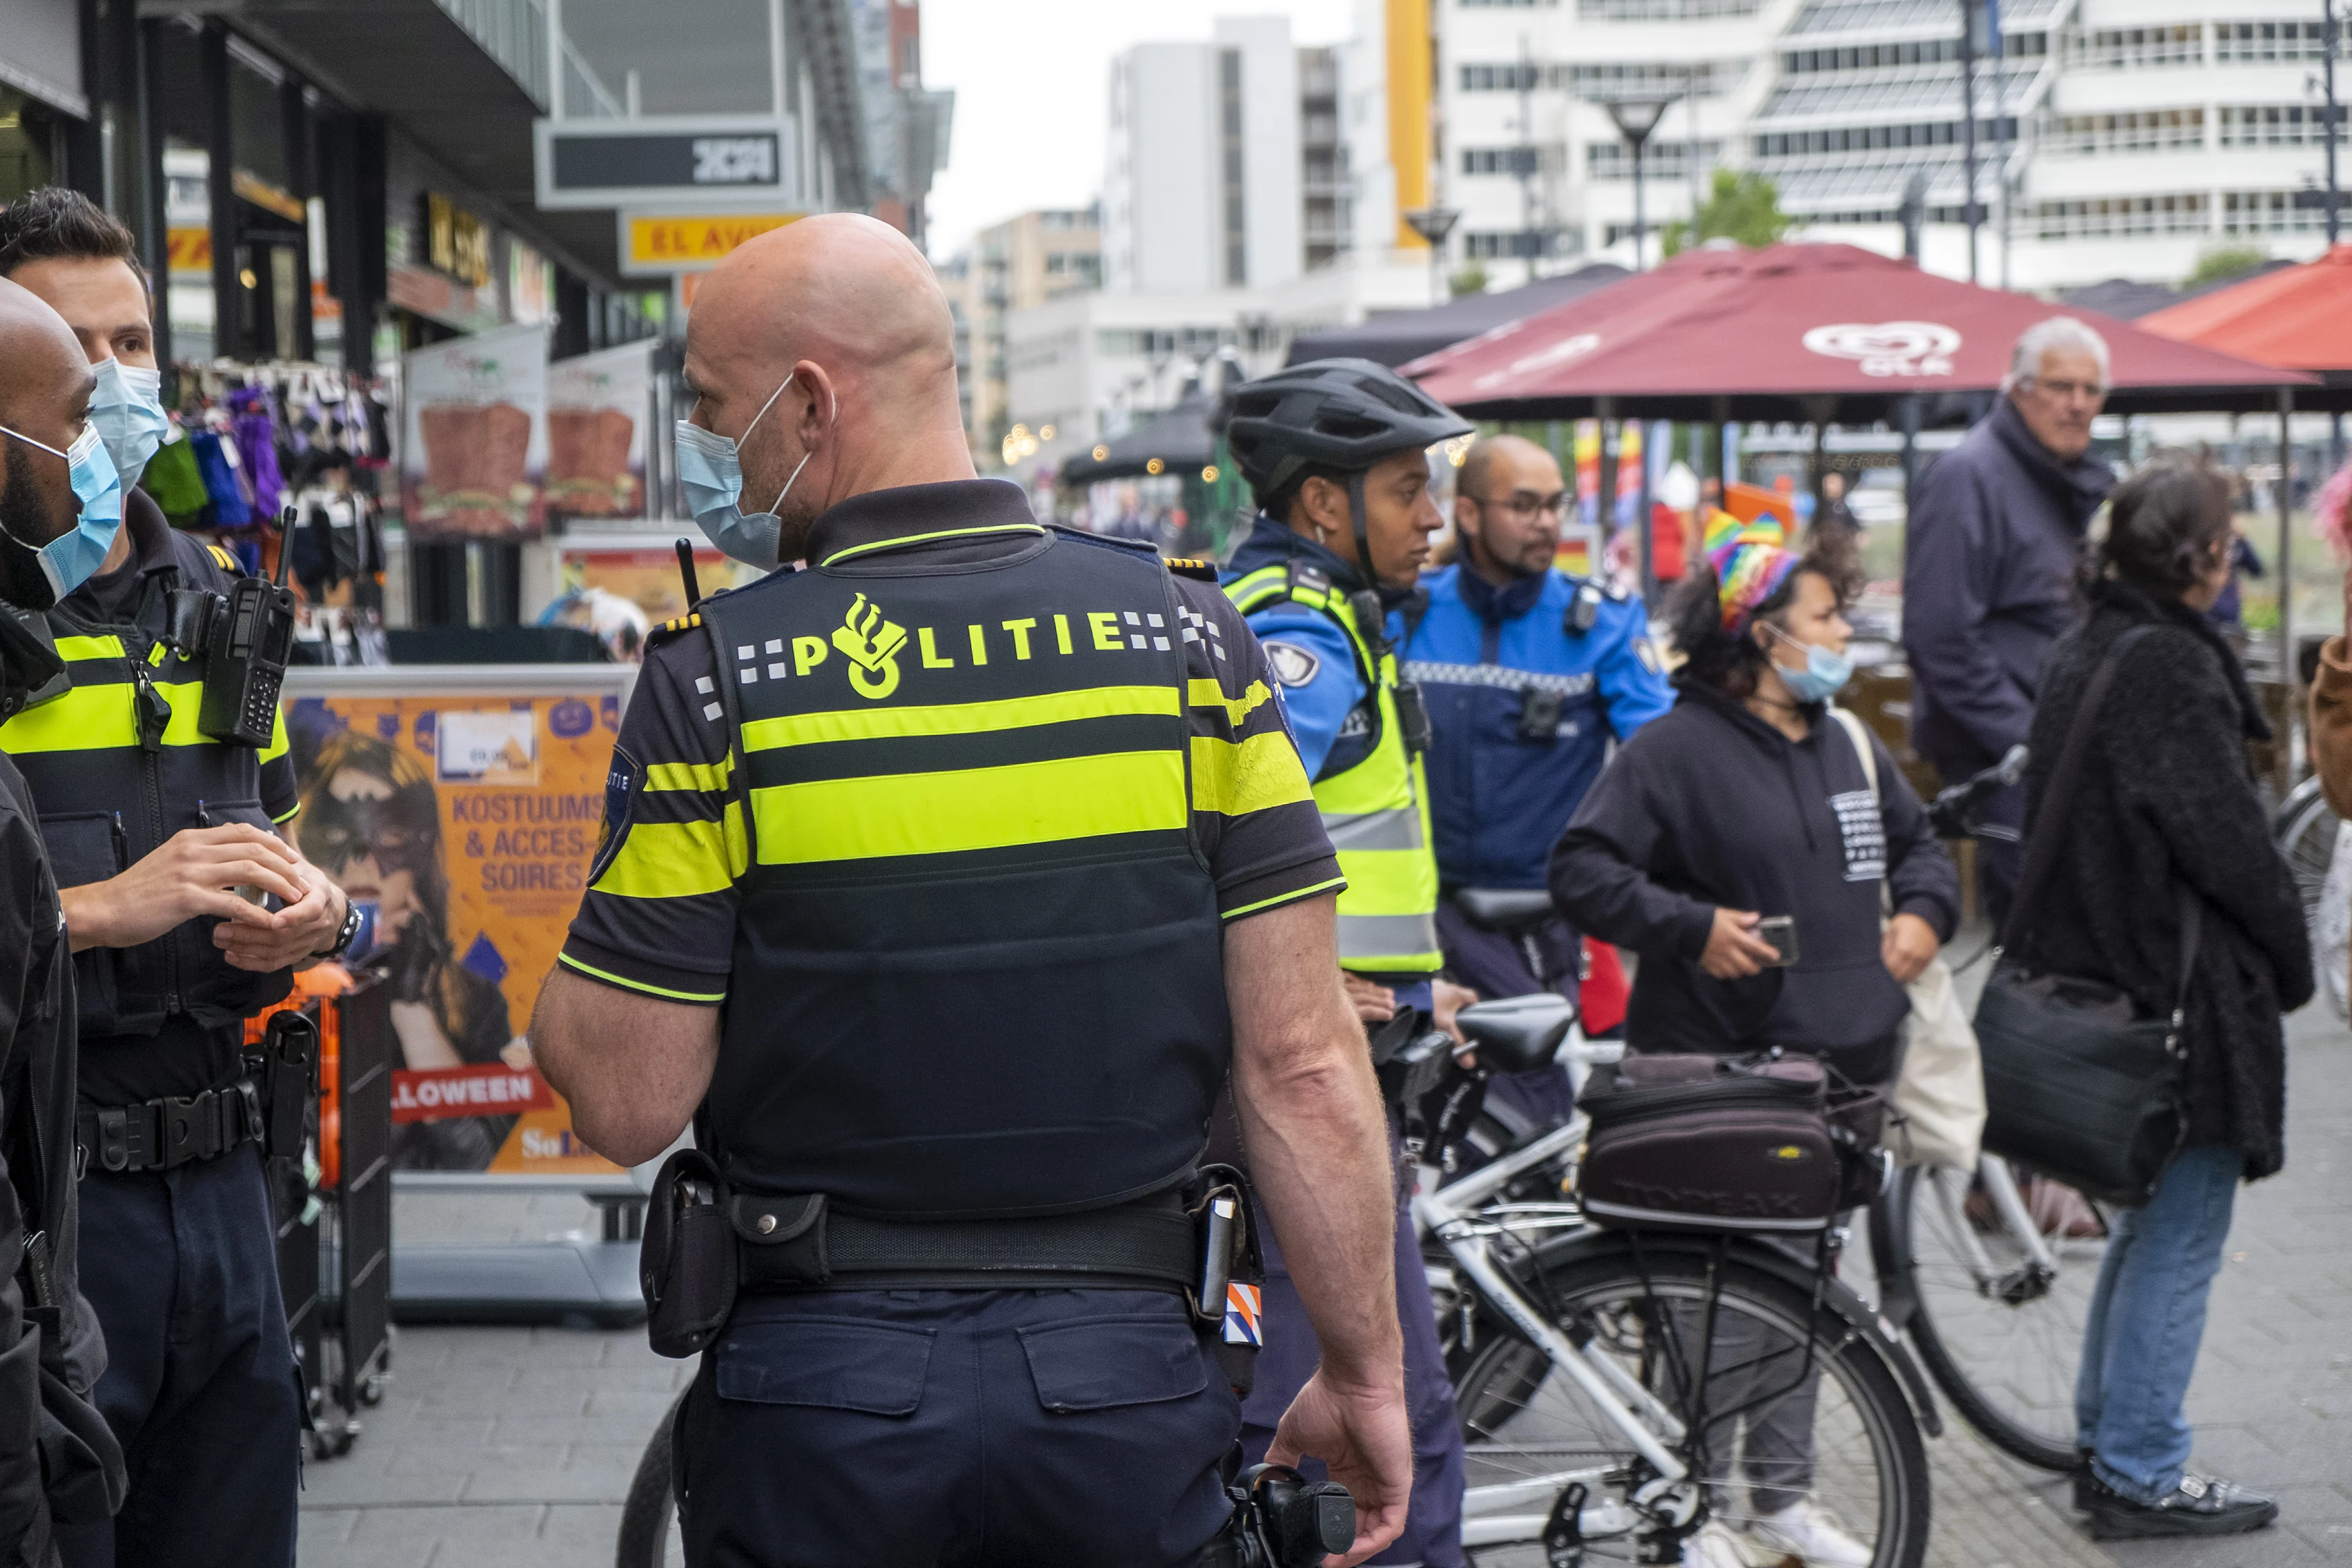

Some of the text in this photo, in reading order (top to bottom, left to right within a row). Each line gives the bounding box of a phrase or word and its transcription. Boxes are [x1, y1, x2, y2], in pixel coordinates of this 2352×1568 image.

[651, 225, 688, 255] EL
[452, 793, 605, 824] KOSTUUMS
[464, 829, 484, 858] &
[391, 1075, 533, 1109] LOWEEN
